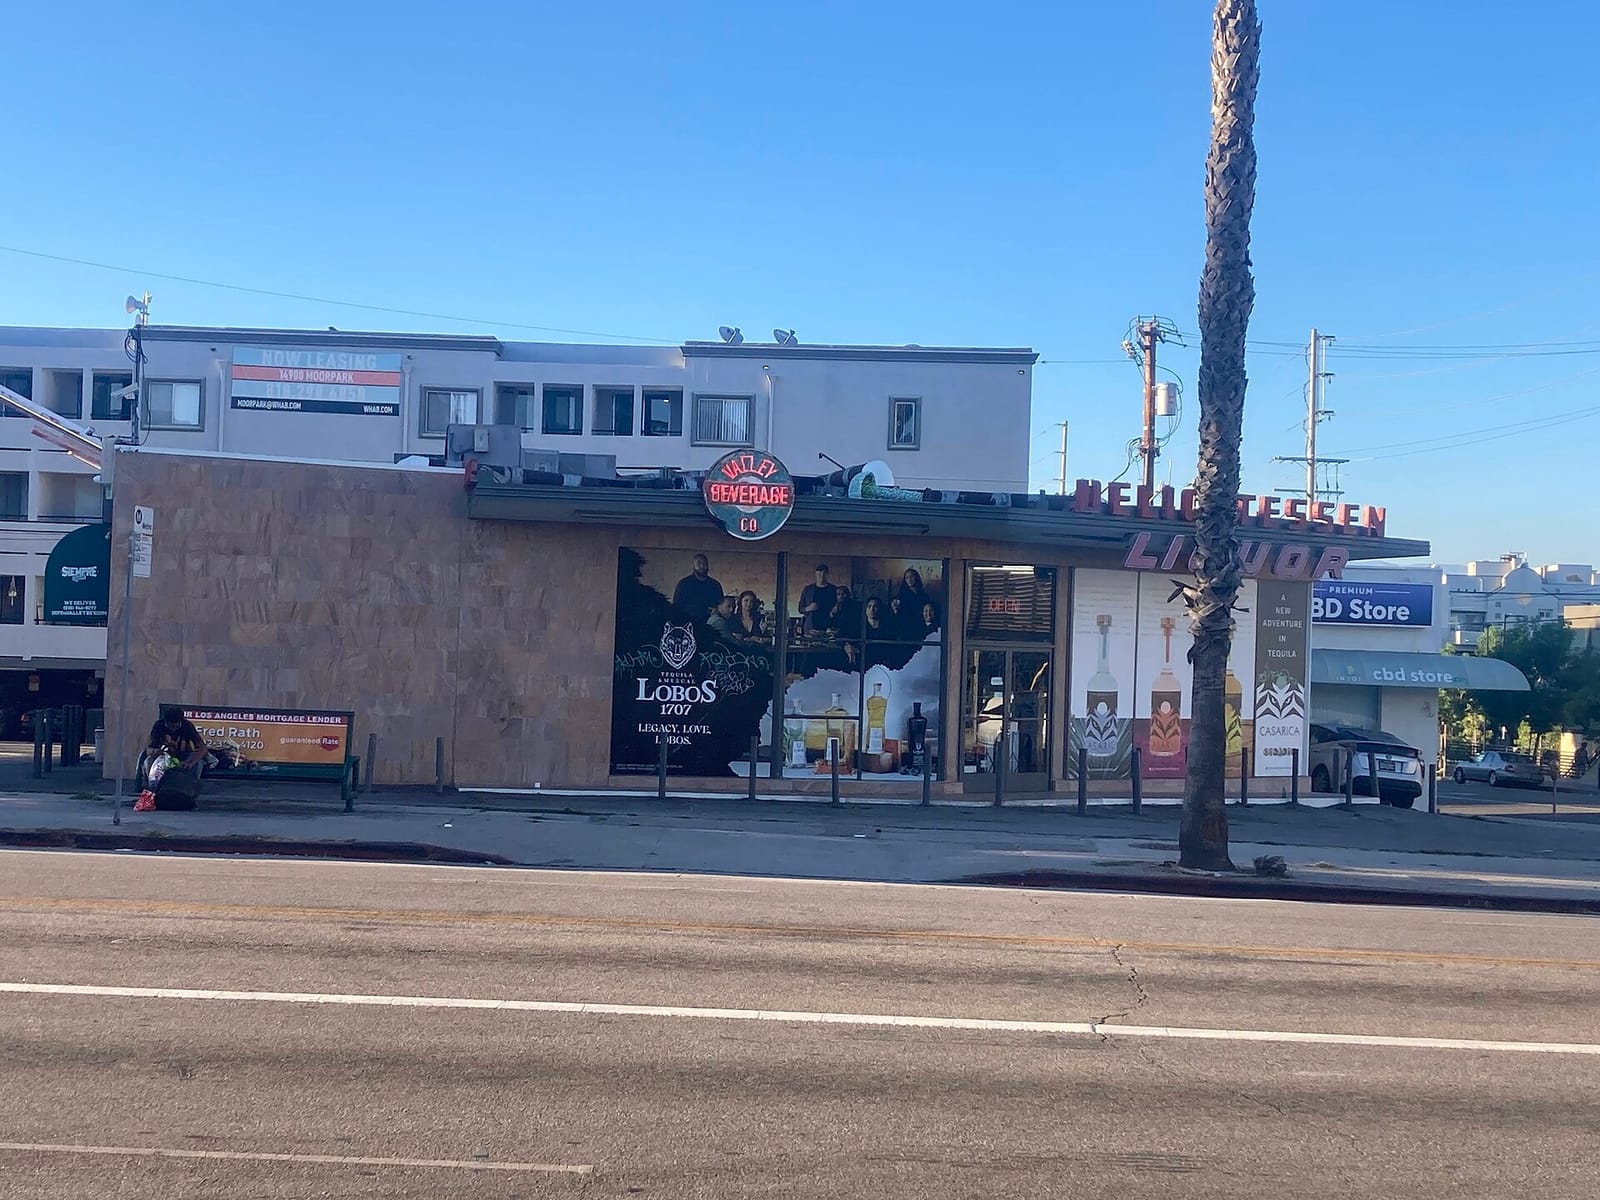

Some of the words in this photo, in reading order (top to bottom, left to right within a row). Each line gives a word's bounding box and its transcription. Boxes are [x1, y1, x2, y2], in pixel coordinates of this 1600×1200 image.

[262, 350, 300, 366] NOW
[307, 352, 377, 369] LEASING
[306, 371, 354, 383] MOORPARK
[721, 455, 778, 479] VALLEY
[710, 483, 789, 504] BEVERAGE
[1074, 479, 1386, 537] DELICTESSEN
[1329, 586, 1373, 595] PREMIUM
[1275, 607, 1291, 615] NEW
[1349, 598, 1410, 621] Store
[1263, 619, 1303, 628] ADVENTURE
[1267, 649, 1297, 658] TEQUILA
[1373, 667, 1405, 681] cbd
[1411, 670, 1453, 683] store
[635, 677, 719, 703] LOBOS
[659, 704, 693, 716] 1707
[195, 711, 213, 719] LOS
[214, 712, 254, 721] ANGELES
[256, 714, 306, 723] MORTGAGE
[307, 715, 342, 724] LENDER
[228, 727, 261, 738] Rath
[1259, 725, 1300, 737] CASARICA
